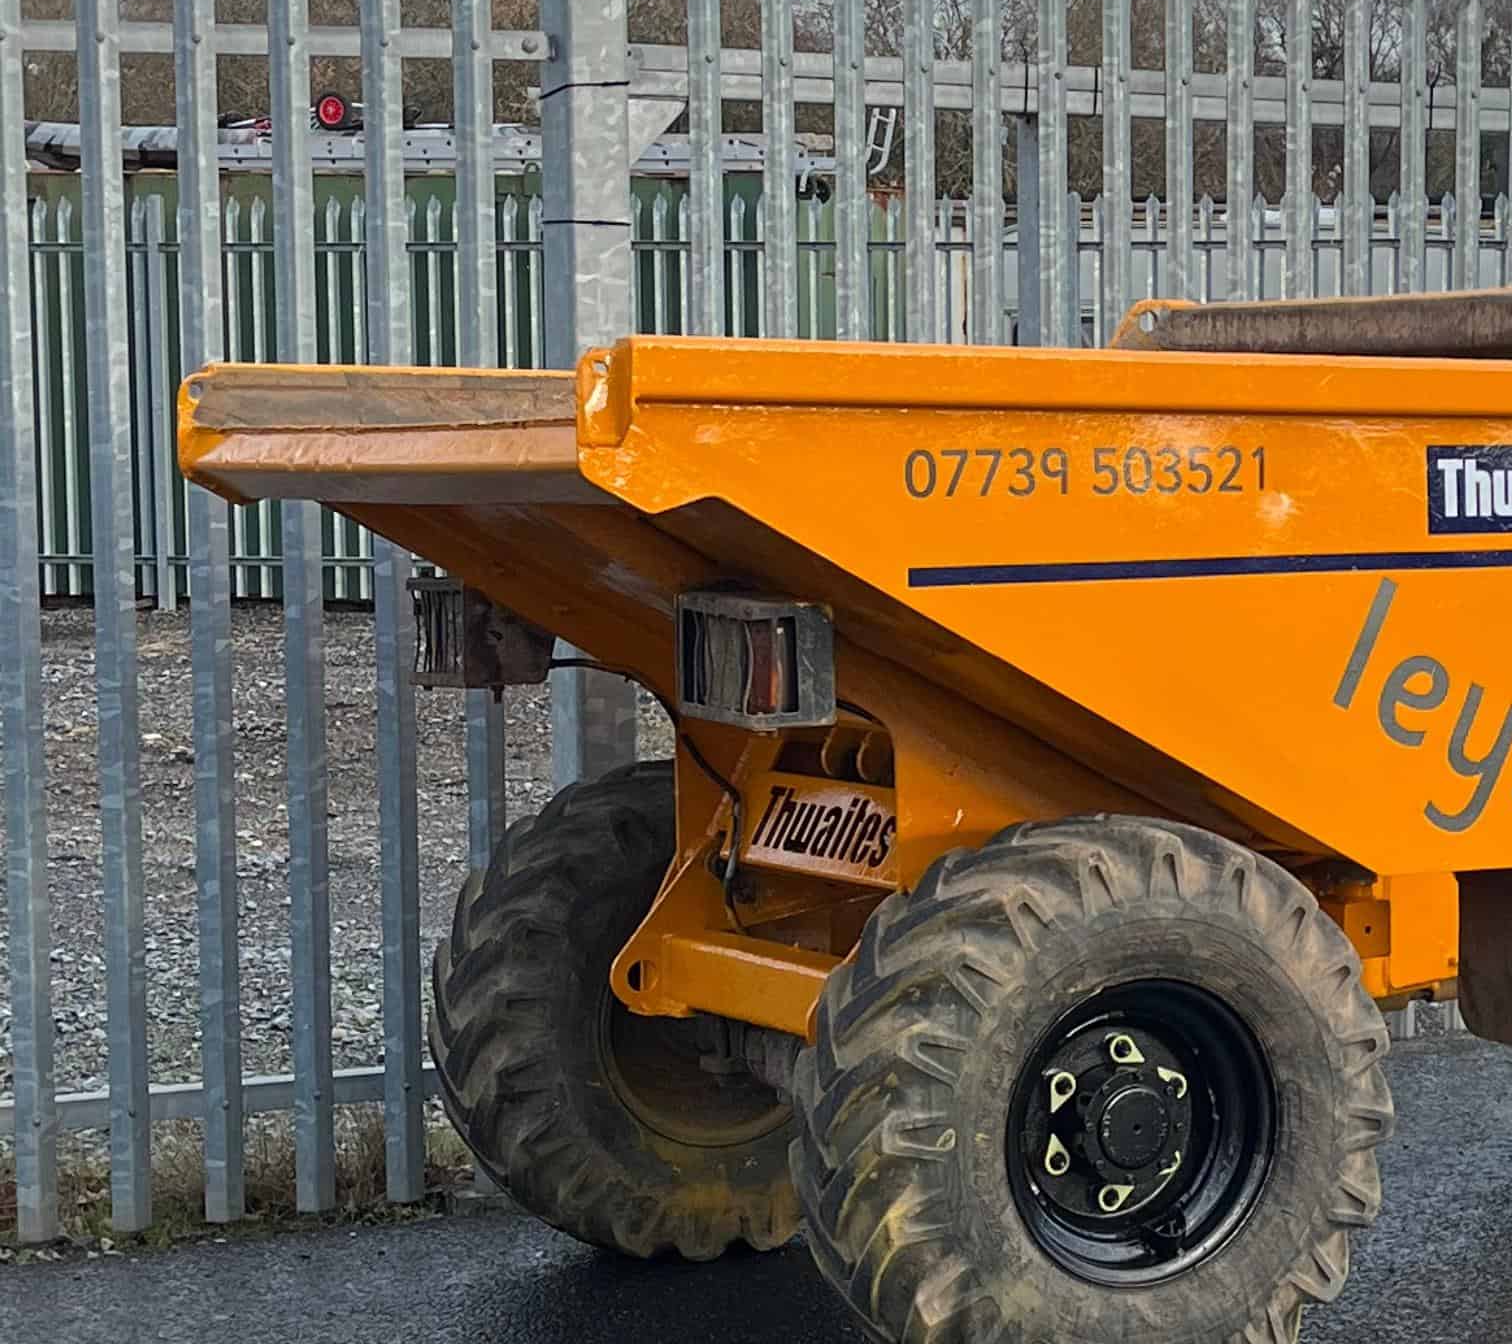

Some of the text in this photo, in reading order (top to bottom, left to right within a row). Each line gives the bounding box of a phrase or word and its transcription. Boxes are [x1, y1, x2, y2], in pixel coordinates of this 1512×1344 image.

[904, 444, 1266, 499] 07739 503521
[751, 784, 897, 869] Thwaites
